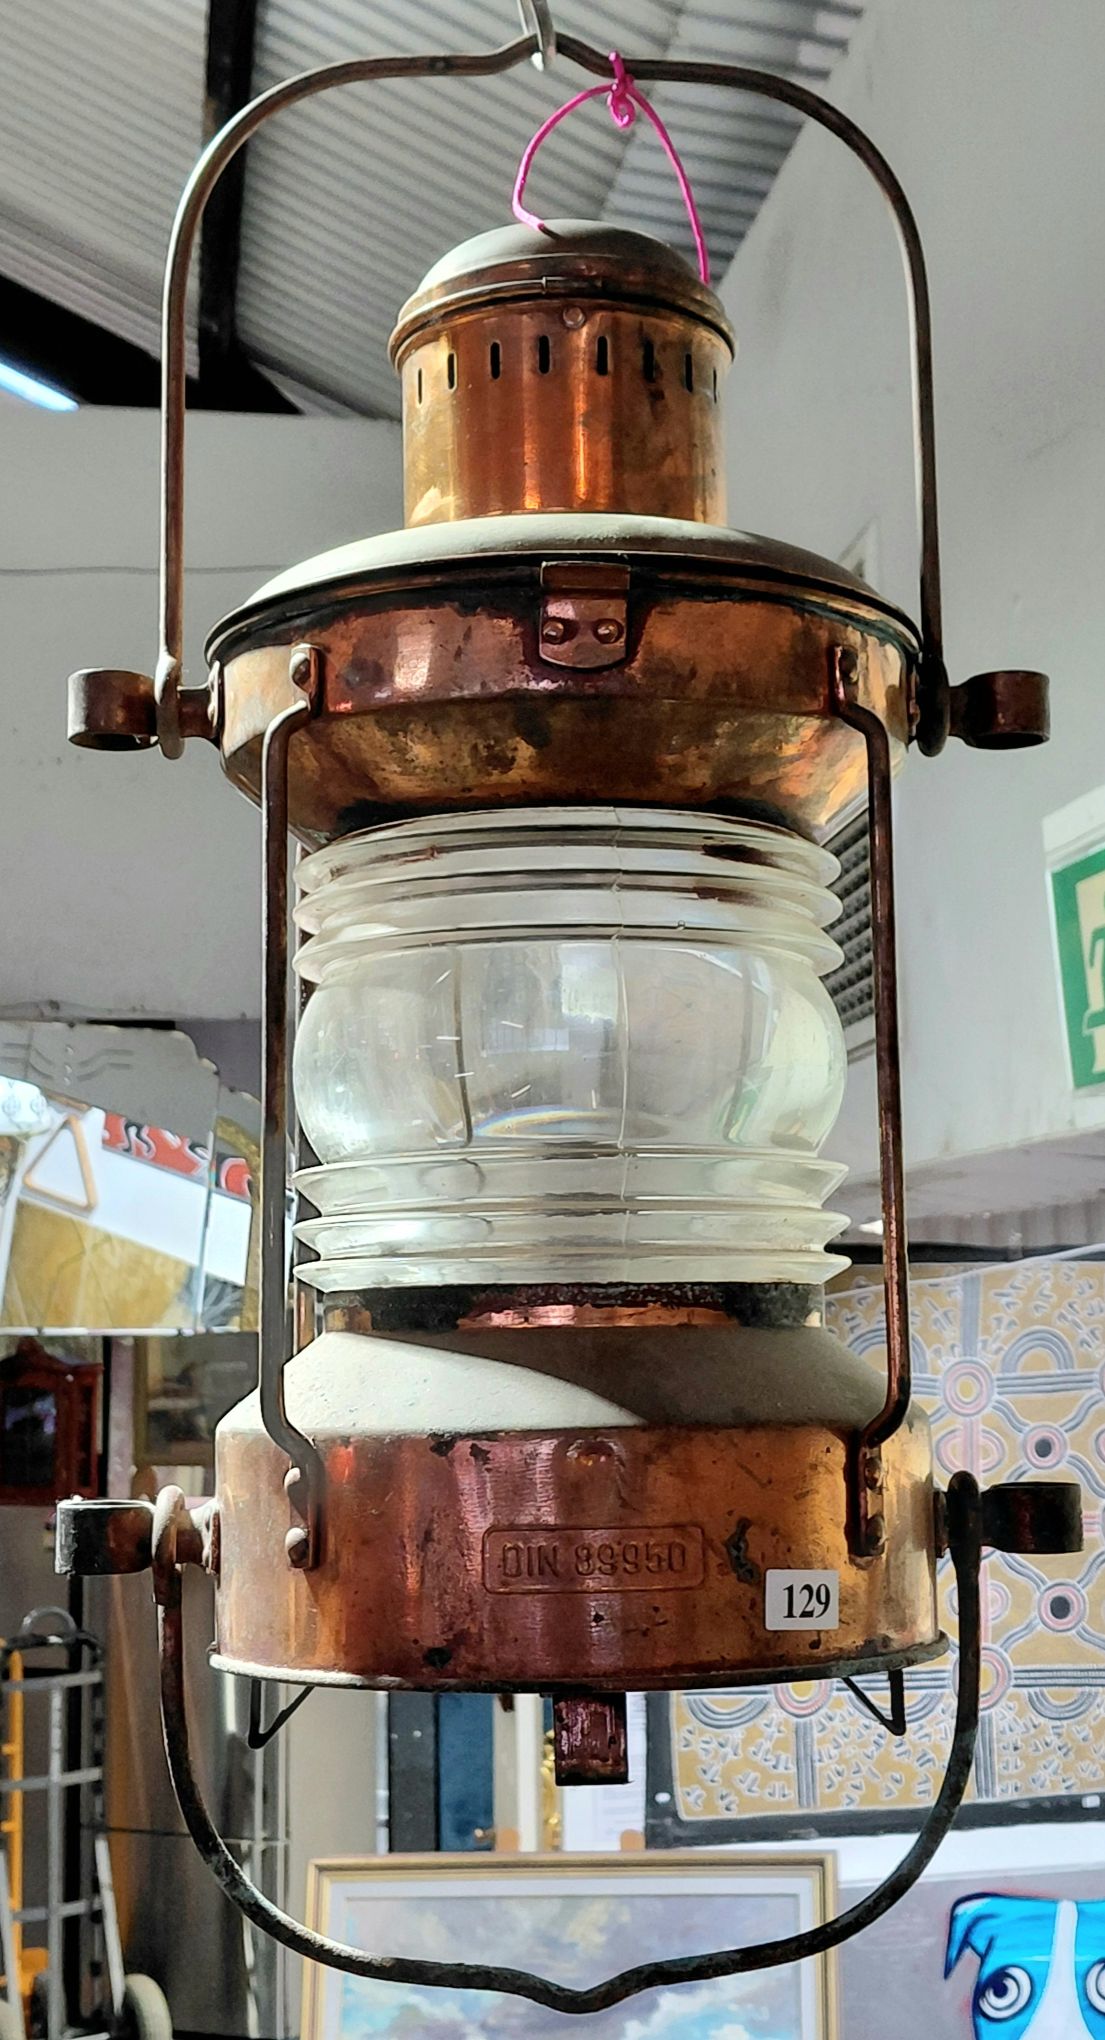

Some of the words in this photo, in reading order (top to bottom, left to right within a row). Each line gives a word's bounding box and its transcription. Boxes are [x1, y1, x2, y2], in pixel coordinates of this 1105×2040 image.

[502, 1542, 559, 1578] DIN
[574, 1541, 687, 1576] 89950
[782, 1583, 831, 1619] 129
